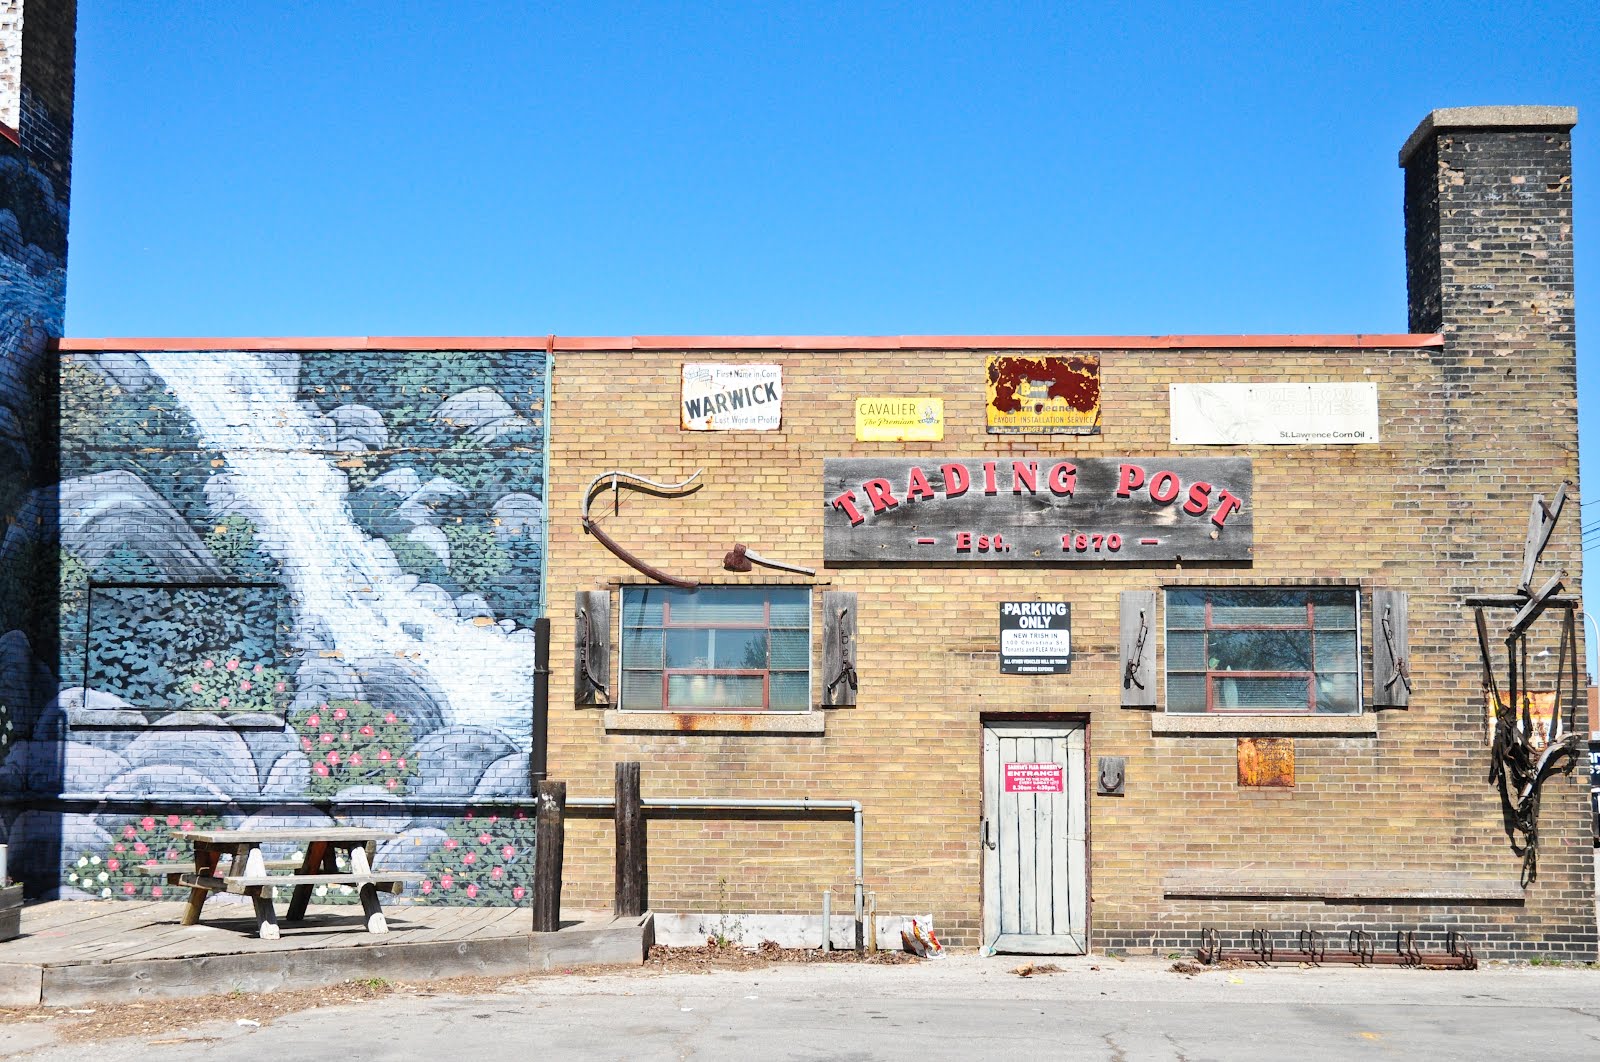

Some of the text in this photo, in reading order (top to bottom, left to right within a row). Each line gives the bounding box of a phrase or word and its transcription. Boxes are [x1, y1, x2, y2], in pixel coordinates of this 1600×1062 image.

[716, 369, 733, 378] First
[734, 369, 752, 378] Name
[753, 369, 760, 378] in
[761, 369, 777, 378] Corn
[685, 381, 778, 420] WARWICK
[859, 403, 916, 415] CAVALIER
[731, 416, 749, 424] Word
[757, 415, 778, 424] Profit
[863, 418, 877, 426] The
[877, 417, 914, 427] Premium
[1020, 416, 1064, 424] INSTALLATION
[1353, 430, 1365, 438] Oil
[832, 460, 1242, 528] TRADING POST
[956, 531, 1122, 553] Est. 1870
[1004, 603, 1067, 616] PARKING
[1019, 616, 1052, 629] ONLY
